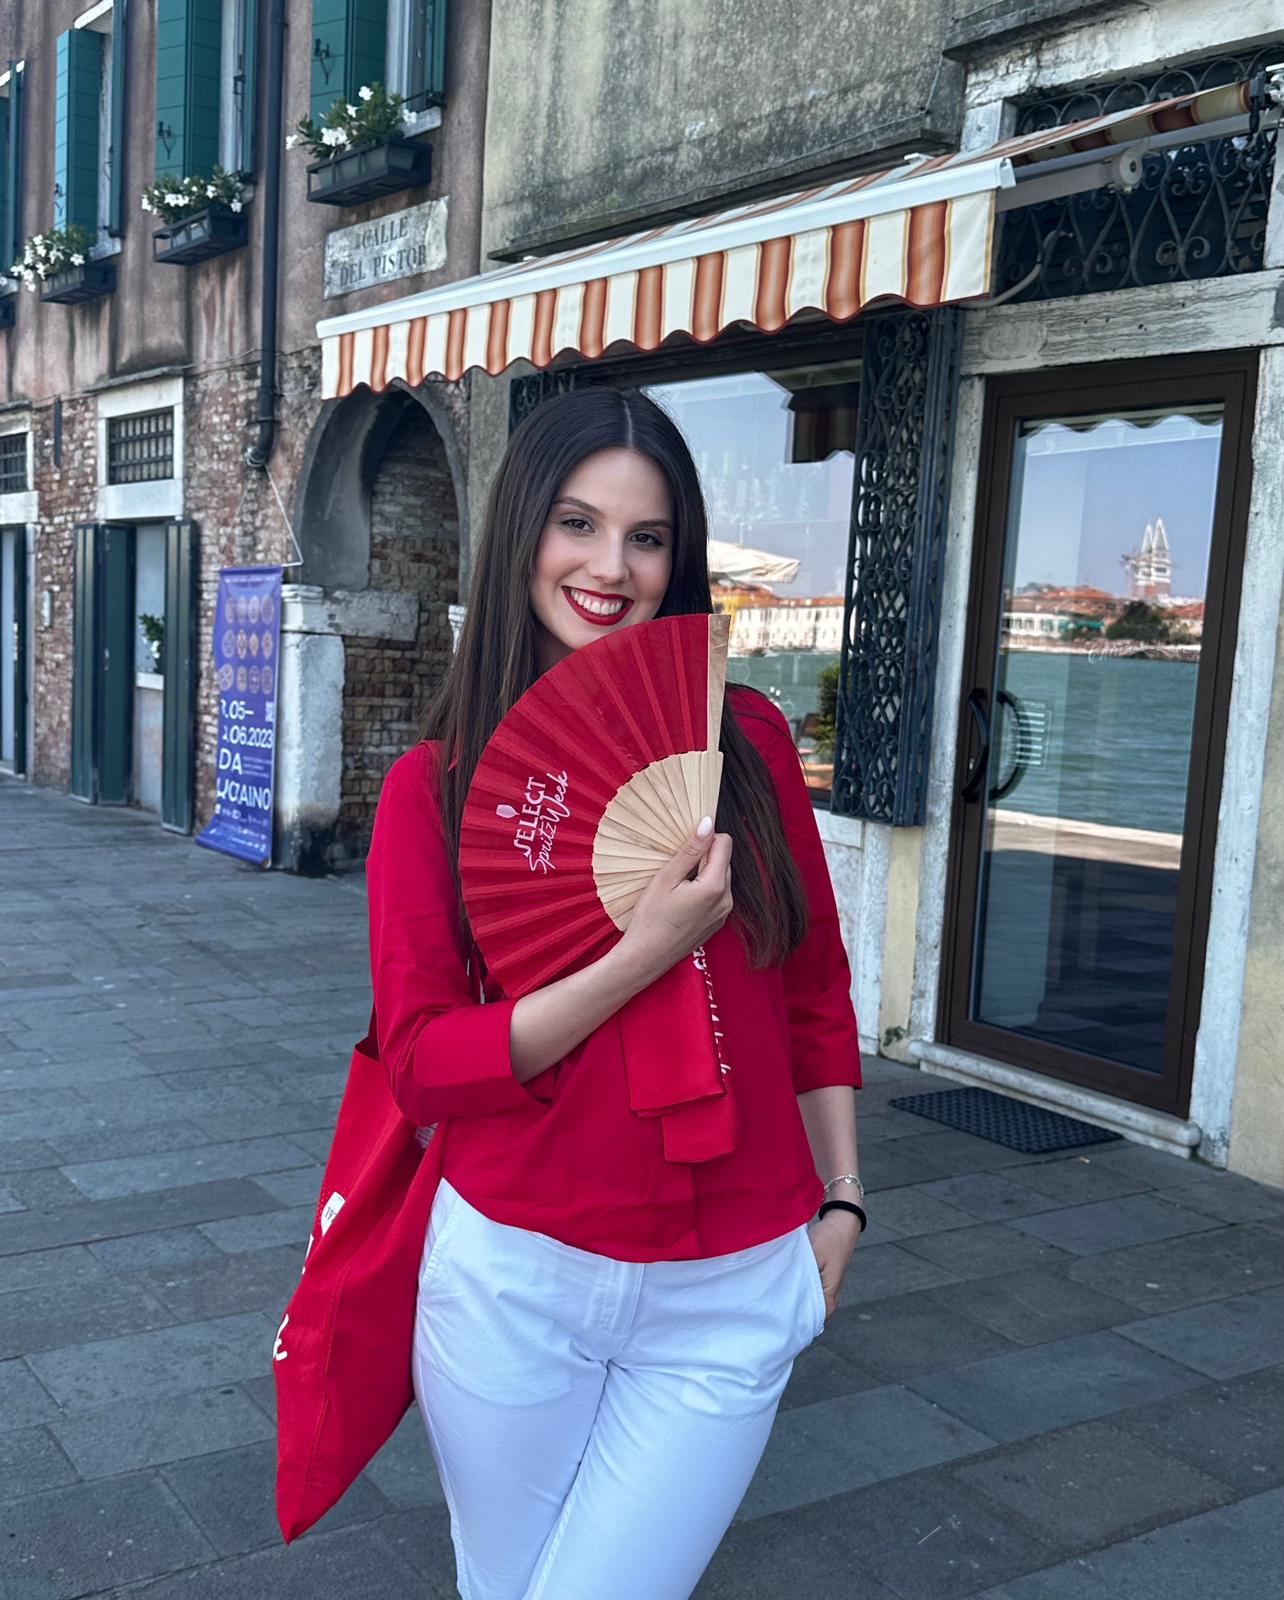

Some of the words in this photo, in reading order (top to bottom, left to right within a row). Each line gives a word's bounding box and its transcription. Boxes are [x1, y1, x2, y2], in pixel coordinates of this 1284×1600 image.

[362, 216, 408, 249] CALLE
[340, 261, 367, 286] DEL
[373, 244, 427, 277] PISTOR
[513, 776, 546, 858] SELECT
